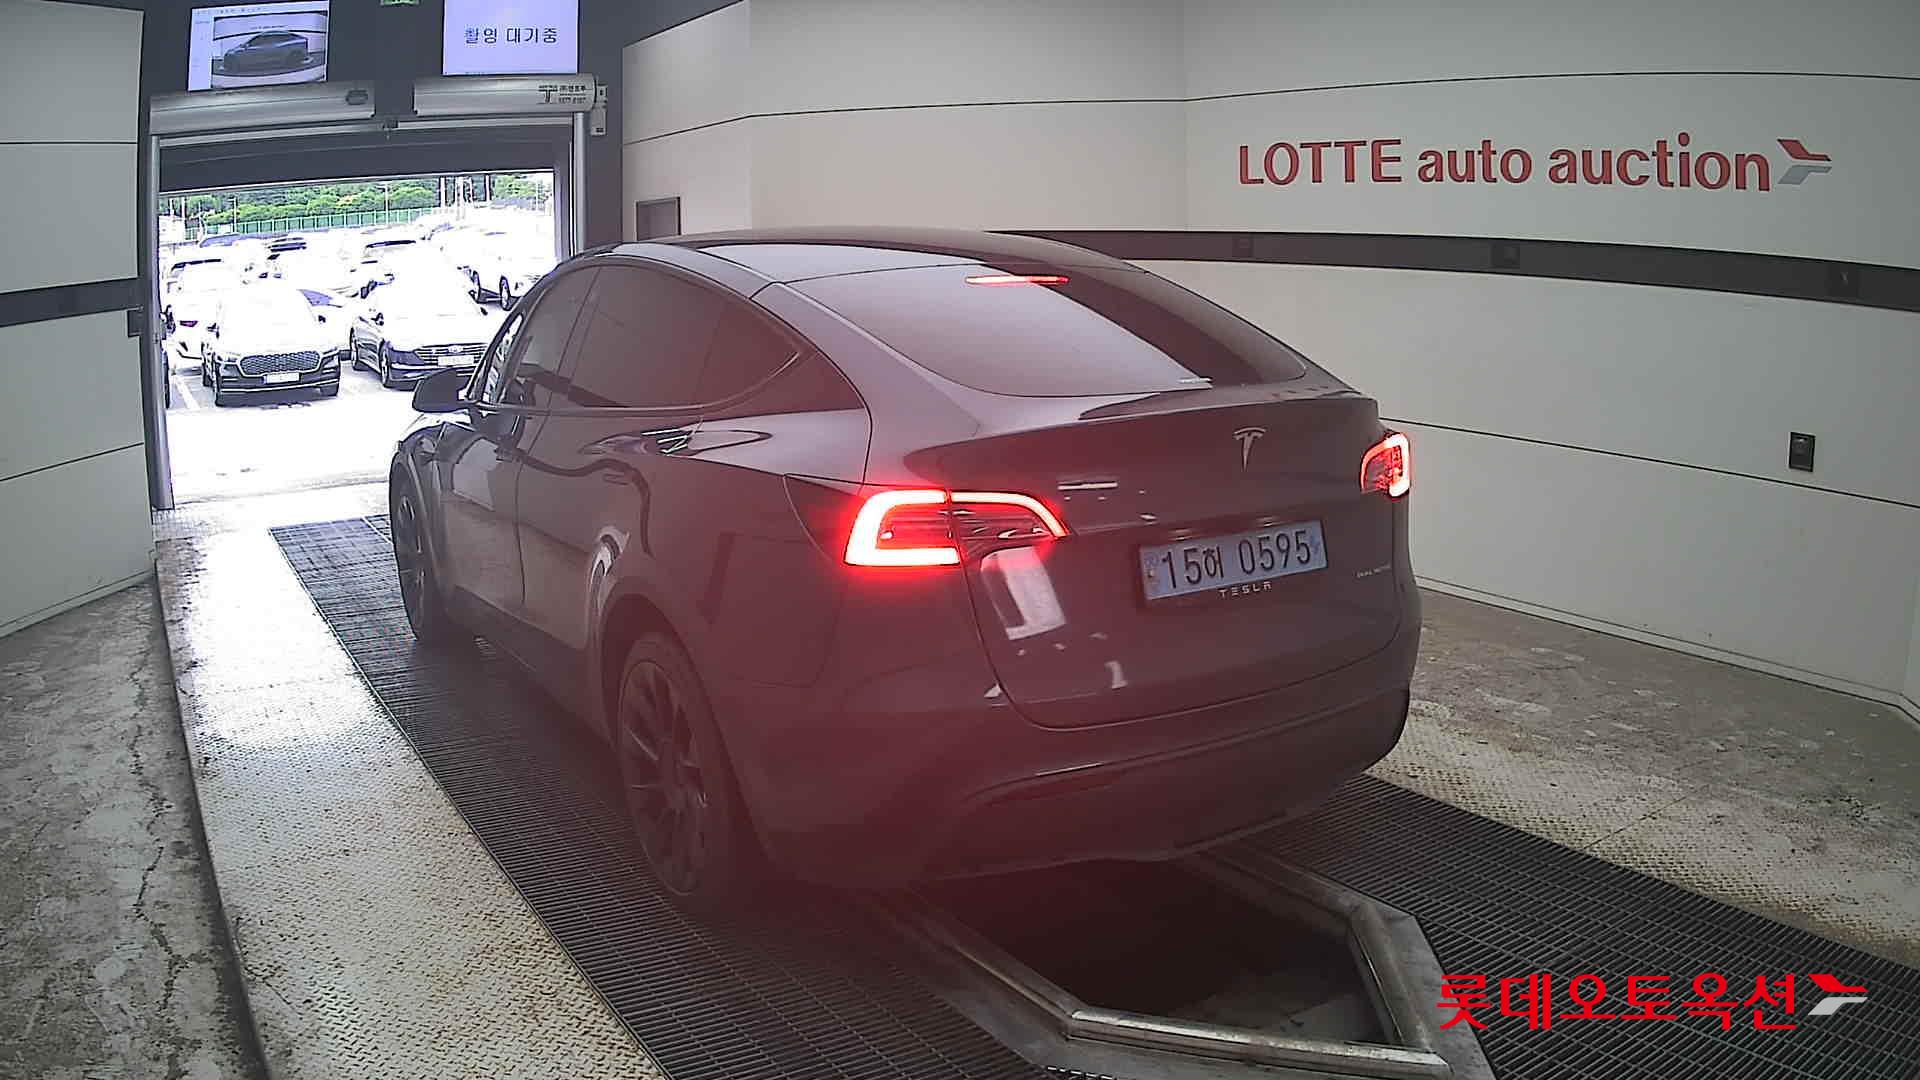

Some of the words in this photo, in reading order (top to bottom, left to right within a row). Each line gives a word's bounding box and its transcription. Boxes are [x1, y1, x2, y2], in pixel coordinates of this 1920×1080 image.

[506, 27, 557, 44] 대기중
[1239, 138, 1402, 186] LOTTE
[1417, 139, 1533, 185] auto
[1548, 132, 1771, 192] auction
[1161, 545, 1225, 589] 15허
[1238, 529, 1312, 576] 0595
[1217, 581, 1272, 598] TESLA
